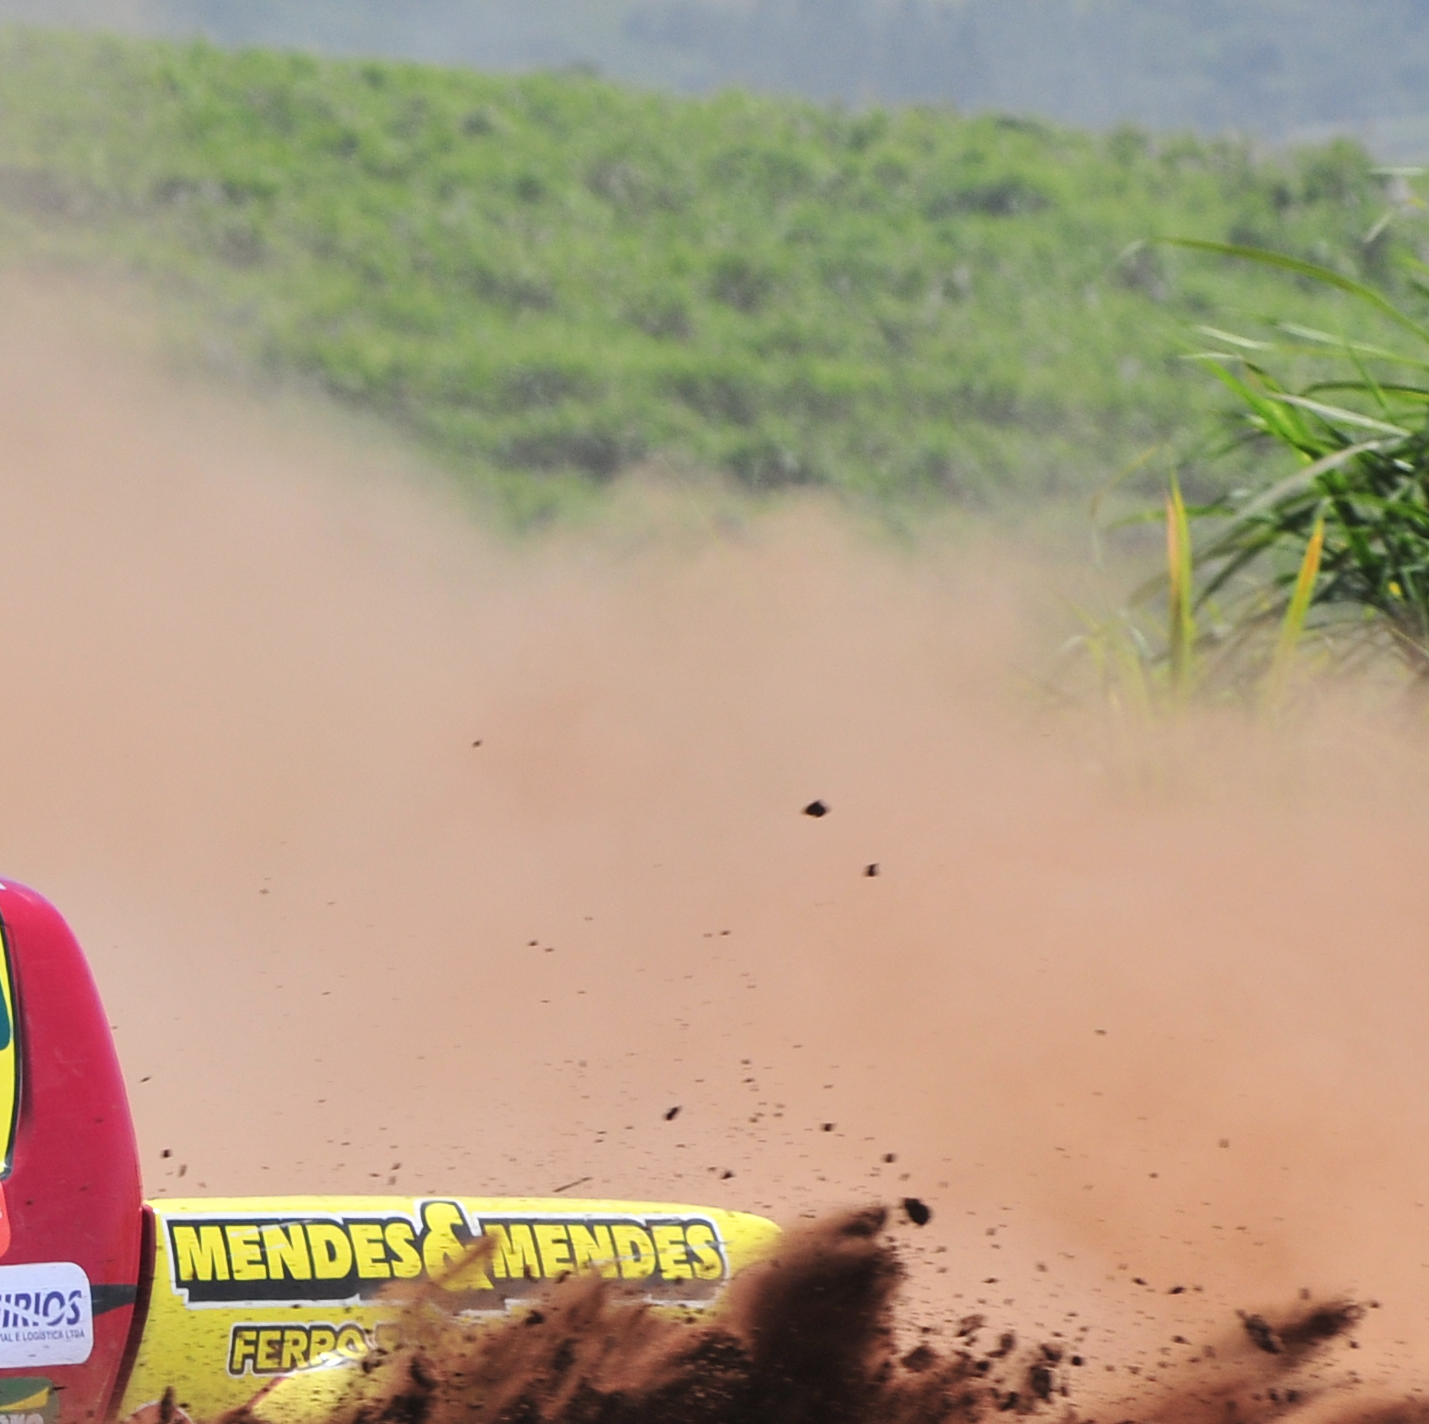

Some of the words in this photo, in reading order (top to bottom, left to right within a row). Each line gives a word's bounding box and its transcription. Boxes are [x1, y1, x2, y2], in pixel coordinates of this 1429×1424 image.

[172, 1222, 422, 1282] MENDES
[422, 1201, 496, 1291] &
[484, 1222, 725, 1281] MENDES
[232, 1328, 369, 1372] FERRO
